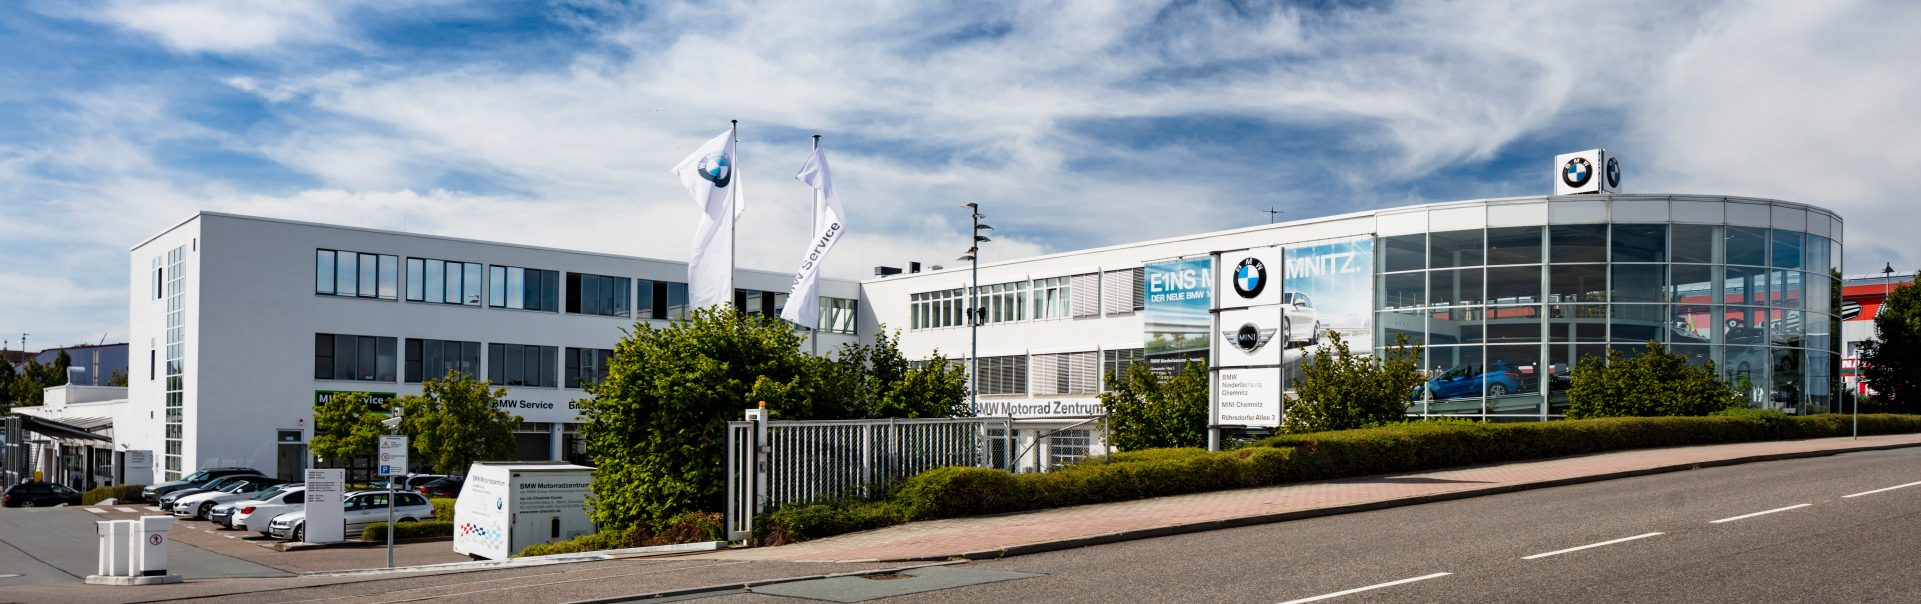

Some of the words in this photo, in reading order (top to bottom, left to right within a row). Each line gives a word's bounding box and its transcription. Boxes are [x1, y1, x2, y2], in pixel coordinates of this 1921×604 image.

[802, 222, 840, 271] Service
[1151, 269, 1197, 292] E1NS
[1201, 268, 1211, 288] M
[1285, 251, 1360, 279] MNITZ.
[1235, 258, 1264, 273] BMW
[1151, 294, 1165, 302] DER
[1166, 292, 1185, 301] NEUE
[1186, 290, 1205, 300] BMW
[1239, 333, 1256, 341] MINI
[519, 400, 554, 410] Service
[1001, 402, 1051, 415] Motorrad
[1053, 401, 1104, 415] Zentrum
